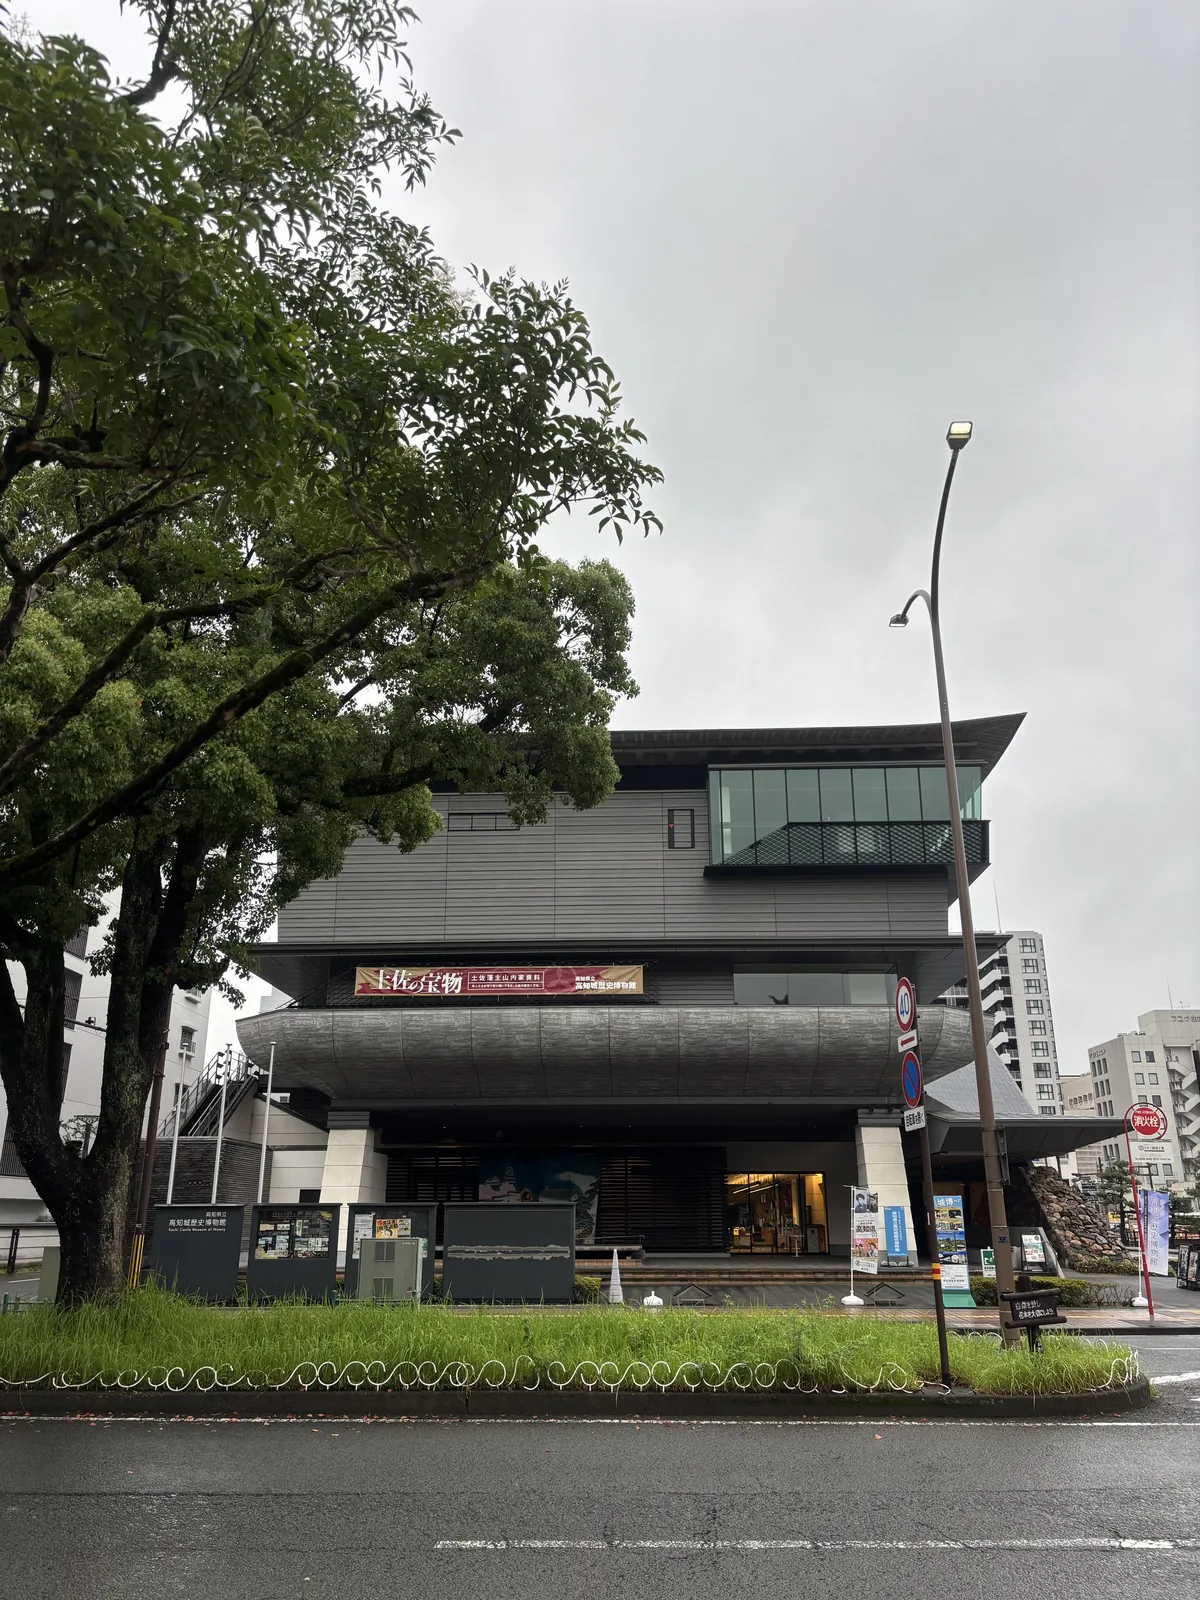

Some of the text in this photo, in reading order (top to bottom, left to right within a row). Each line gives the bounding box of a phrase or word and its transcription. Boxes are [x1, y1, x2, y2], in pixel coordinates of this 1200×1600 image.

[370, 969, 463, 994] 土佐の宝物
[471, 974, 540, 982] 土佐藩主山内家資料
[575, 981, 637, 990] 高知城歴史博物館
[899, 993, 910, 1017] 40
[1133, 1115, 1159, 1128] 消火栓
[168, 1218, 227, 1227] 高知城歴史博物館
